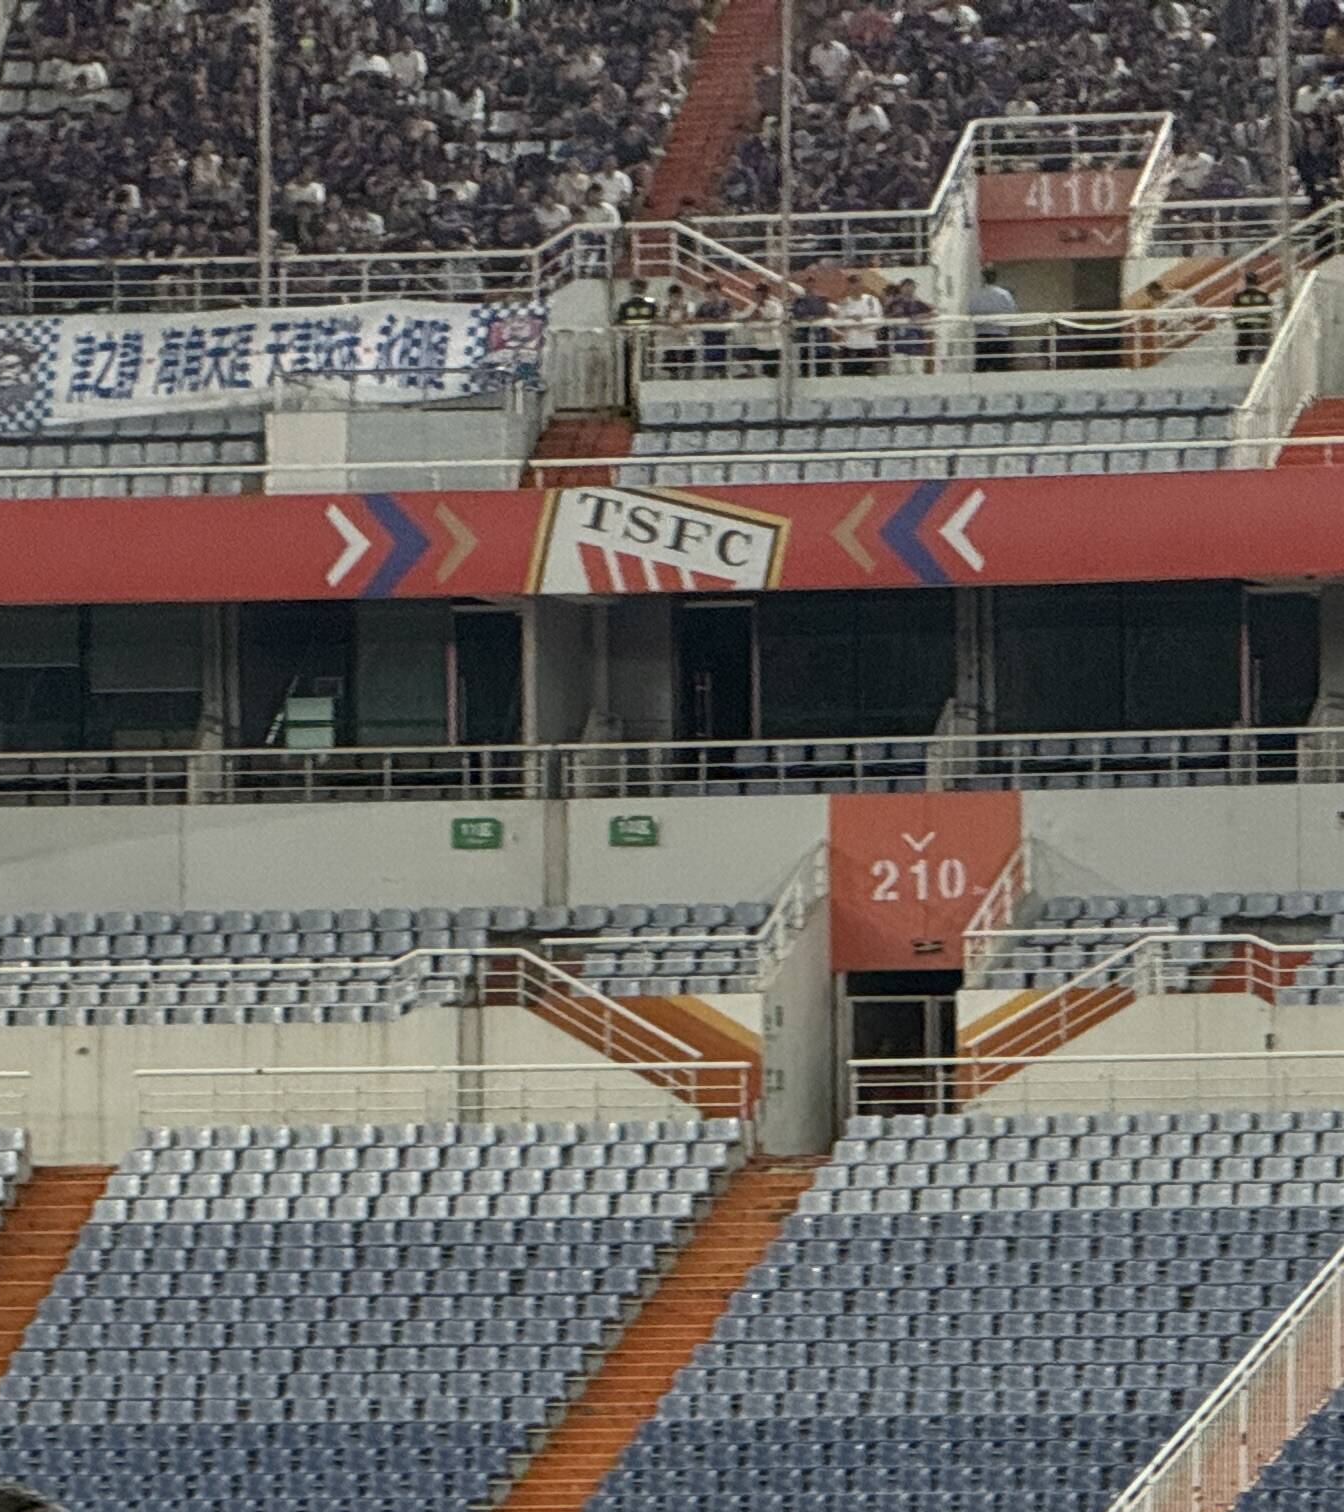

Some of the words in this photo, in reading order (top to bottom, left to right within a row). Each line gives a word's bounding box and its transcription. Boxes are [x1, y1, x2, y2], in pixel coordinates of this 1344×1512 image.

[1025, 173, 1115, 215] 410
[577, 491, 754, 568] TSFC
[871, 859, 967, 902] 210
